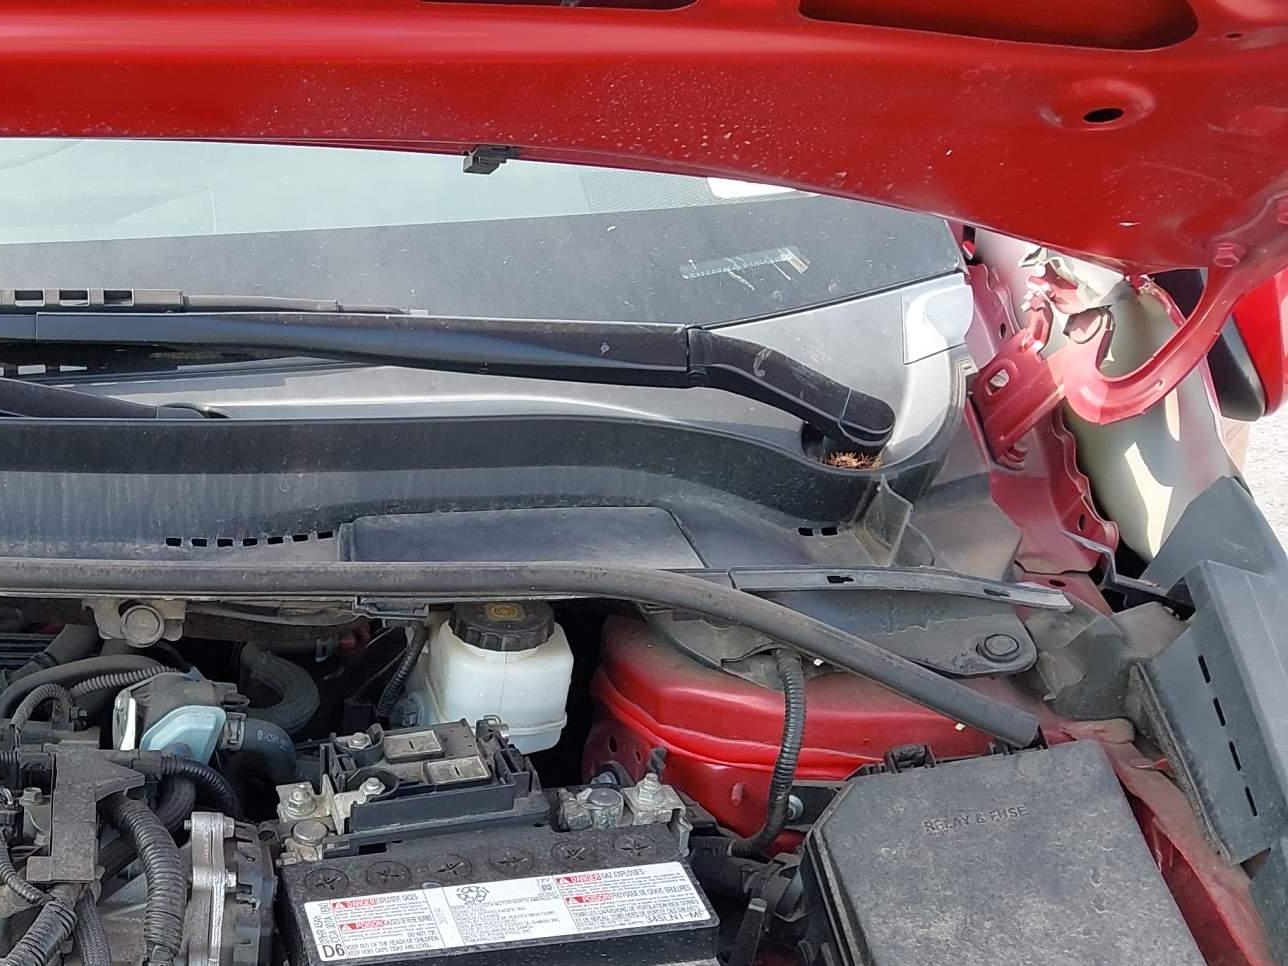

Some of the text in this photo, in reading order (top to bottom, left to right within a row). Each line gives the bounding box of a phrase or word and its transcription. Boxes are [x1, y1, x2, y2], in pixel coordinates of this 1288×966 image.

[922, 806, 1030, 832] RELAY & FUSE
[570, 873, 601, 882] DANGER
[581, 893, 612, 902] POISON
[345, 898, 376, 907] DANGER
[354, 920, 383, 929] POISON
[321, 943, 345, 957] D6
